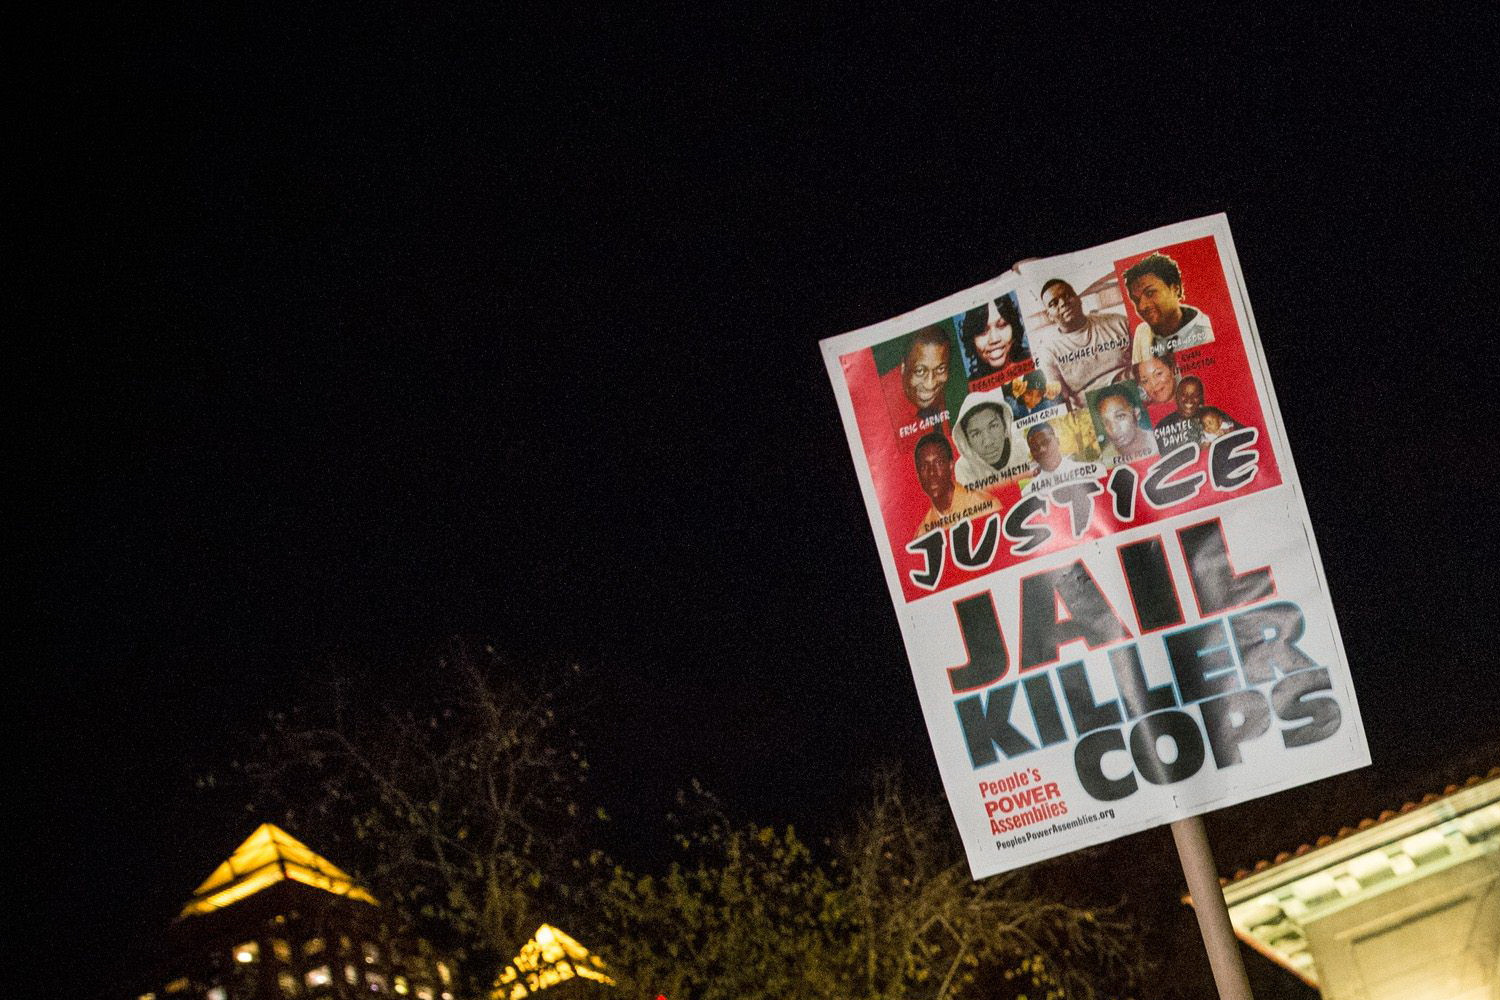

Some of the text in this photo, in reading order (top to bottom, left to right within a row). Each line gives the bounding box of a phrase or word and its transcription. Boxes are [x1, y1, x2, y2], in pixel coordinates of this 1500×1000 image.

[1058, 337, 1130, 364] MICHAEL BROWN
[1166, 333, 1207, 350] CRAWFORD
[900, 410, 950, 438] ERIC GARNER
[1016, 408, 1059, 429] KIMANI GRAY
[1154, 419, 1193, 439] SHANTEL
[1163, 432, 1189, 448] DAVIS
[965, 463, 1031, 493] TRAYVON MARTIN
[1031, 463, 1098, 492] ALAN BLUEFORD
[905, 427, 1258, 592] JUSTICE
[963, 501, 994, 519] GRAHAM
[946, 517, 1277, 694] JAIL
[953, 600, 1320, 770] KILLER
[1073, 667, 1341, 802] COPS
[979, 767, 1042, 798] People's
[984, 782, 1062, 818] POWER
[990, 800, 1069, 836] Assemblies
[996, 808, 1116, 850] PeoplesPowerAssemblies.org
